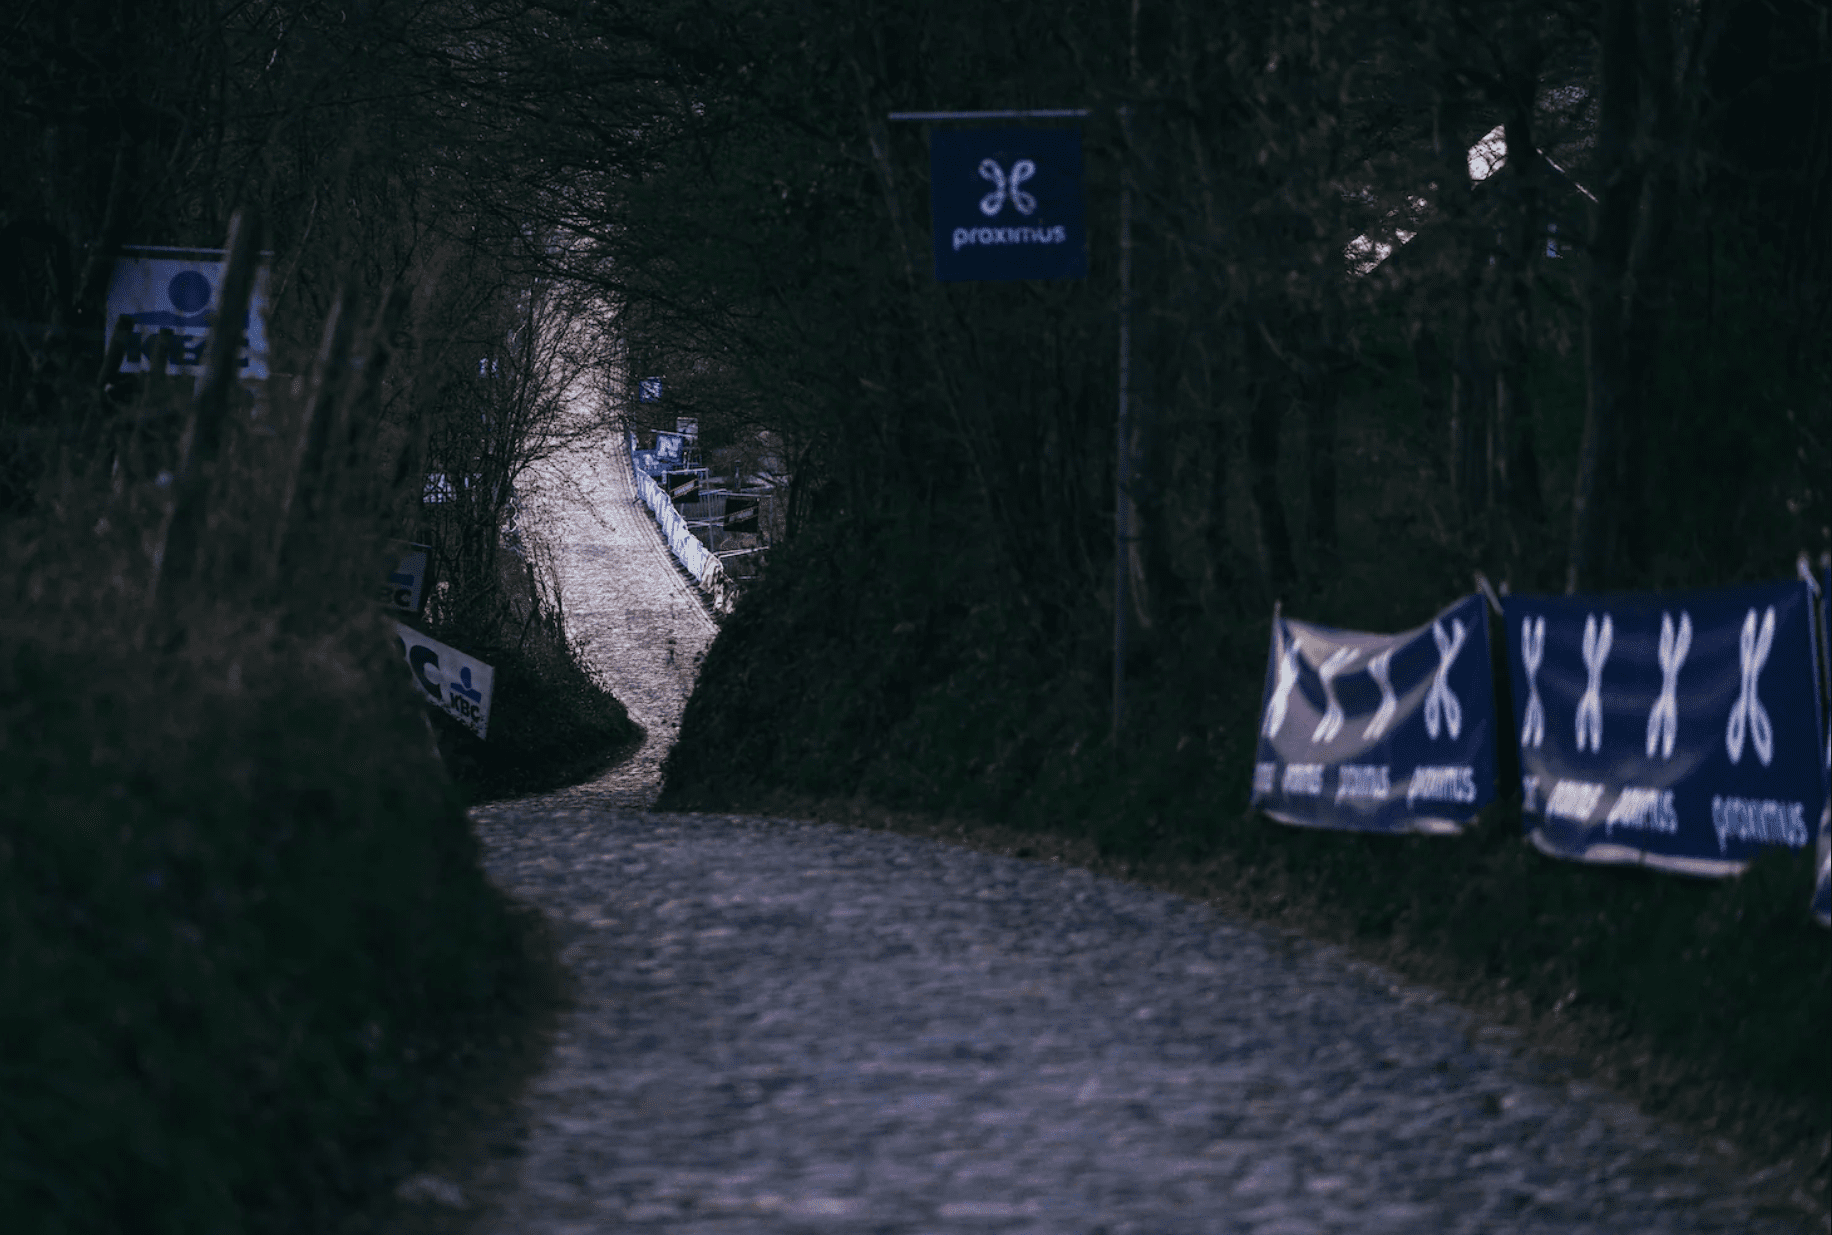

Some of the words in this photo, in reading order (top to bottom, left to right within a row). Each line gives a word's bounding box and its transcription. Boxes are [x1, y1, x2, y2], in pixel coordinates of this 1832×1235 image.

[952, 225, 1067, 251] proximus
[374, 585, 412, 608] BC
[450, 692, 479, 721] KBC
